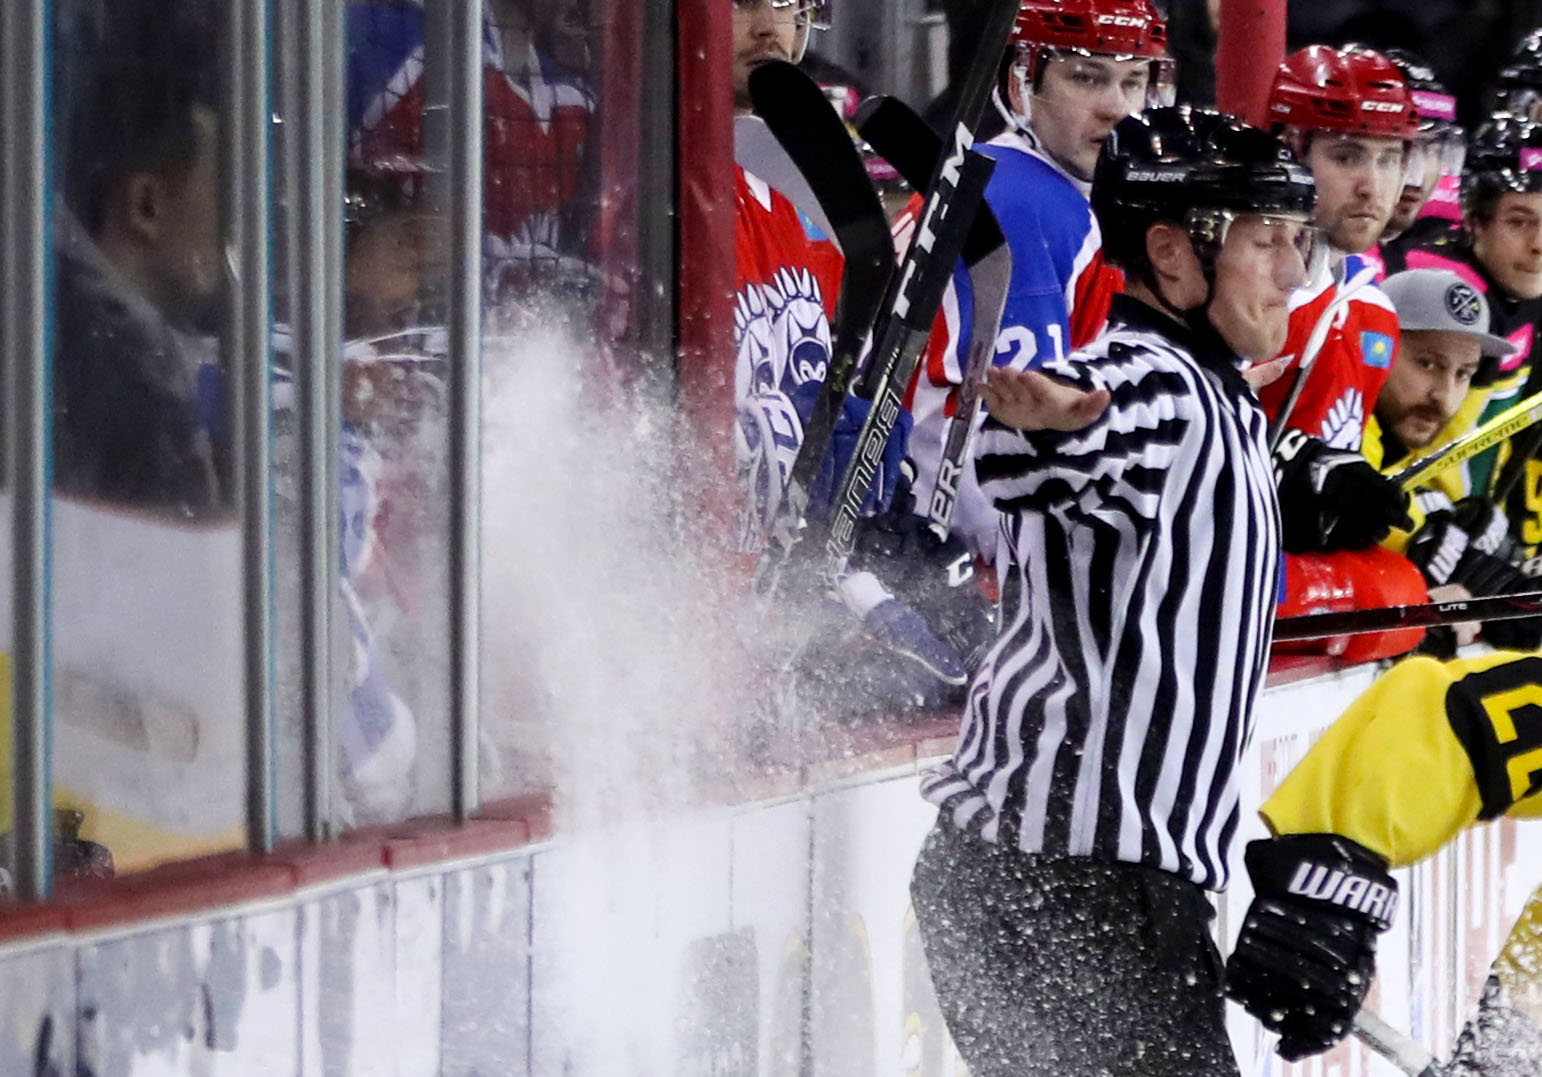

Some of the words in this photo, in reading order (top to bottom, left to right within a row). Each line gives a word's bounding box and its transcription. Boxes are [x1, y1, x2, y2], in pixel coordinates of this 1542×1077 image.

[1097, 14, 1146, 28] CCM
[1361, 100, 1404, 113] CCM
[1126, 170, 1187, 183] BAUER
[1439, 602, 1468, 613] LITE
